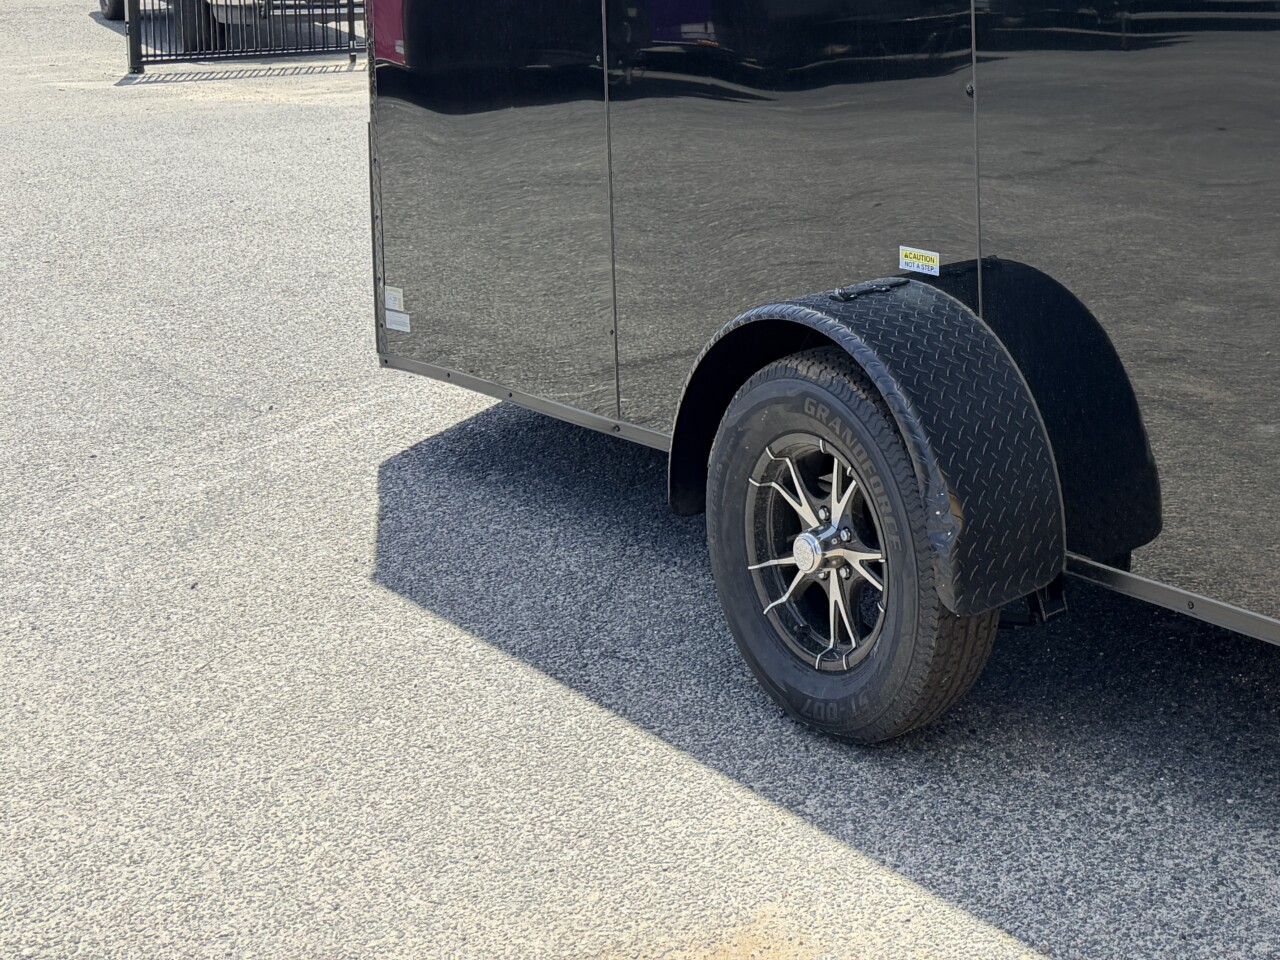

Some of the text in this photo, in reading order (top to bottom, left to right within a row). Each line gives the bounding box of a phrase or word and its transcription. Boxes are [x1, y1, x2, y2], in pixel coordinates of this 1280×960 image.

[908, 252, 935, 264] CAUTION
[904, 260, 915, 269] NOT
[921, 264, 935, 272] STEP
